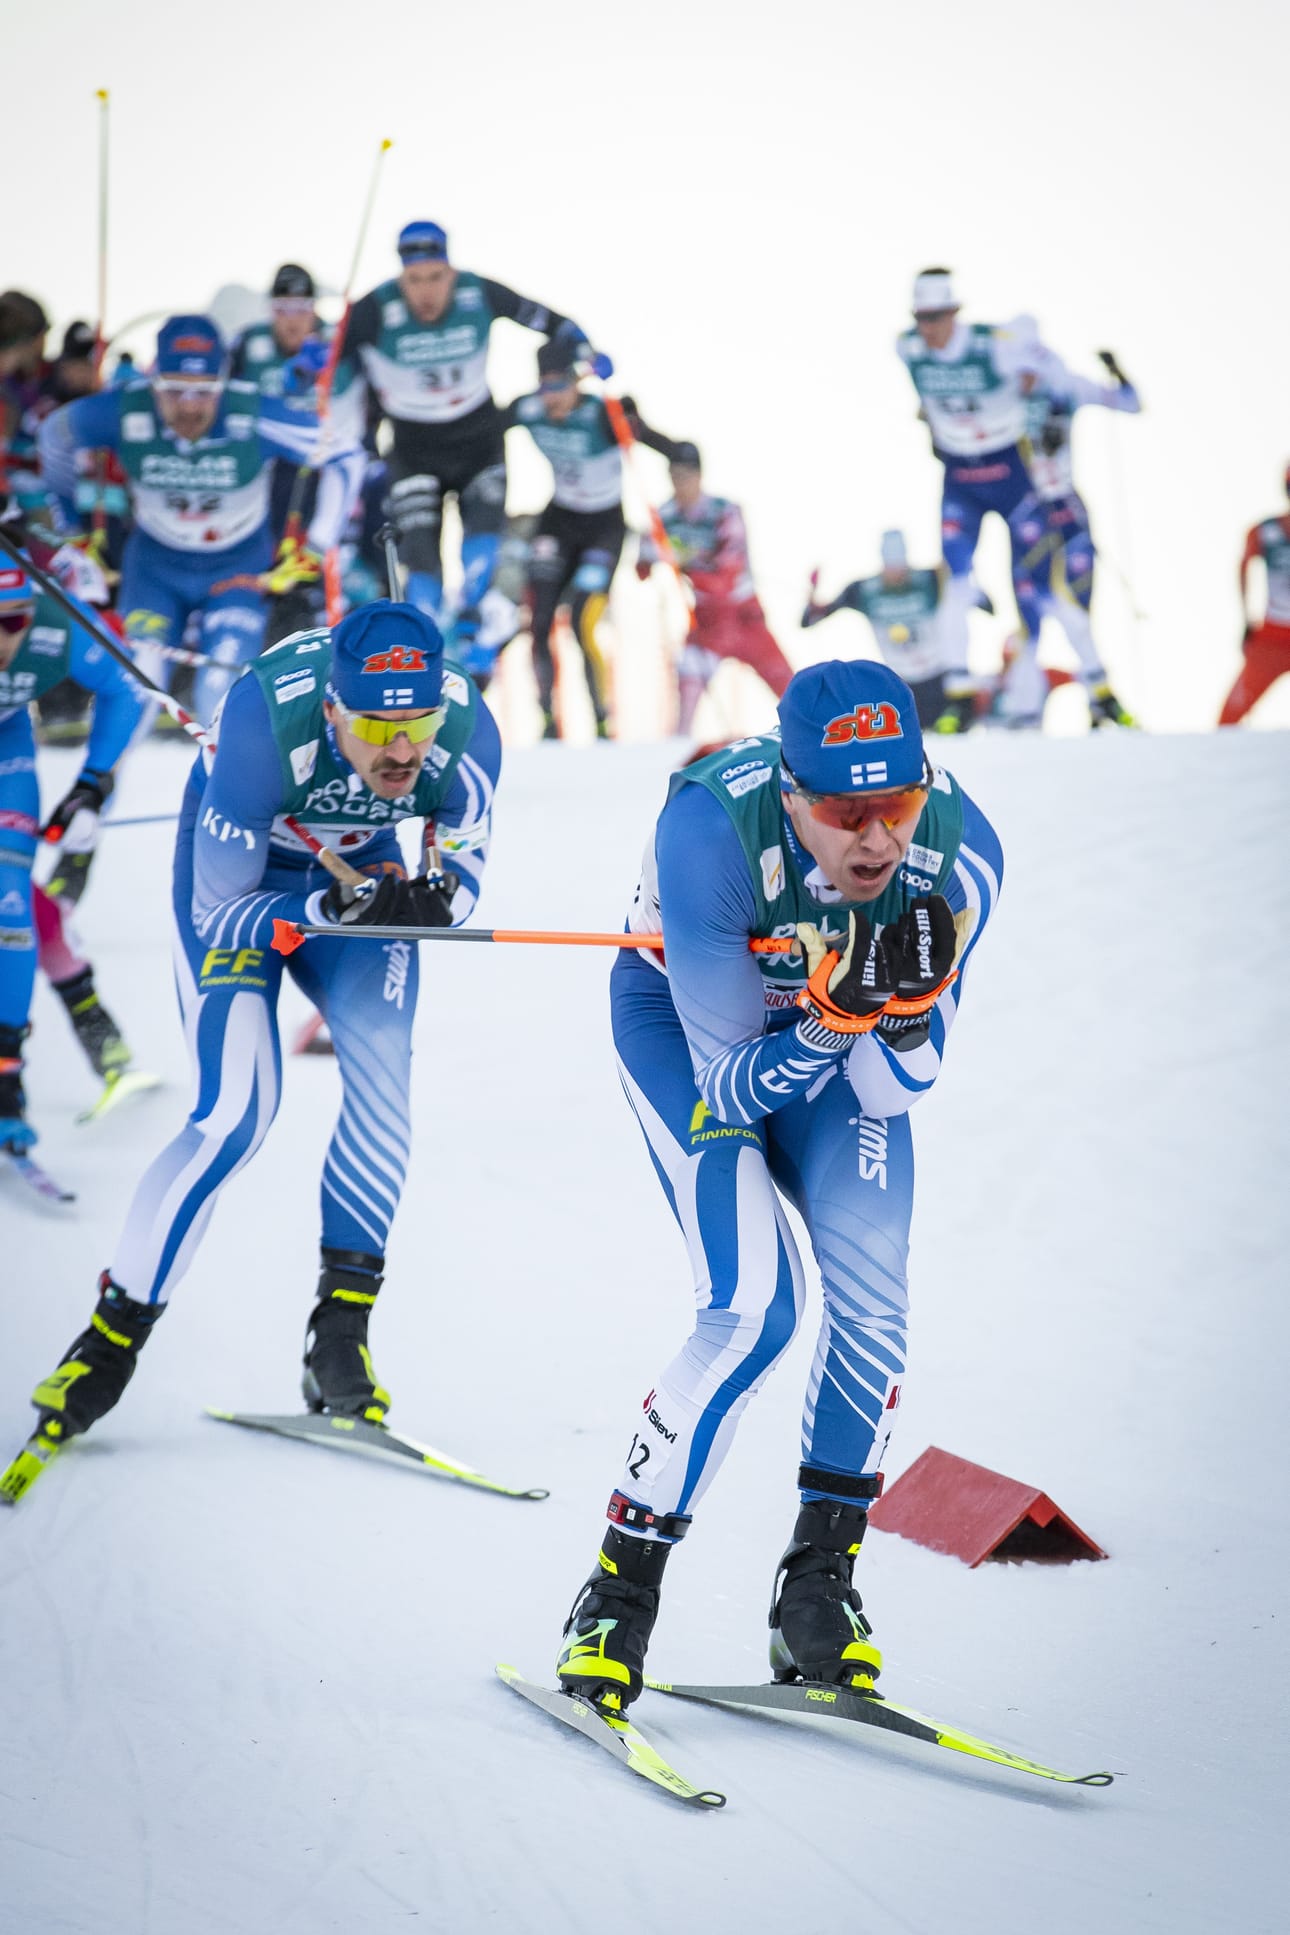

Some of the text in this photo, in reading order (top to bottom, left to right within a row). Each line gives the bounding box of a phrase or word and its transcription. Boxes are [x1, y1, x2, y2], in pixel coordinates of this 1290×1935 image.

[200, 948, 265, 977] FF
[648, 1408, 678, 1444] Sievi
[805, 1689, 837, 1704] FISCHER
